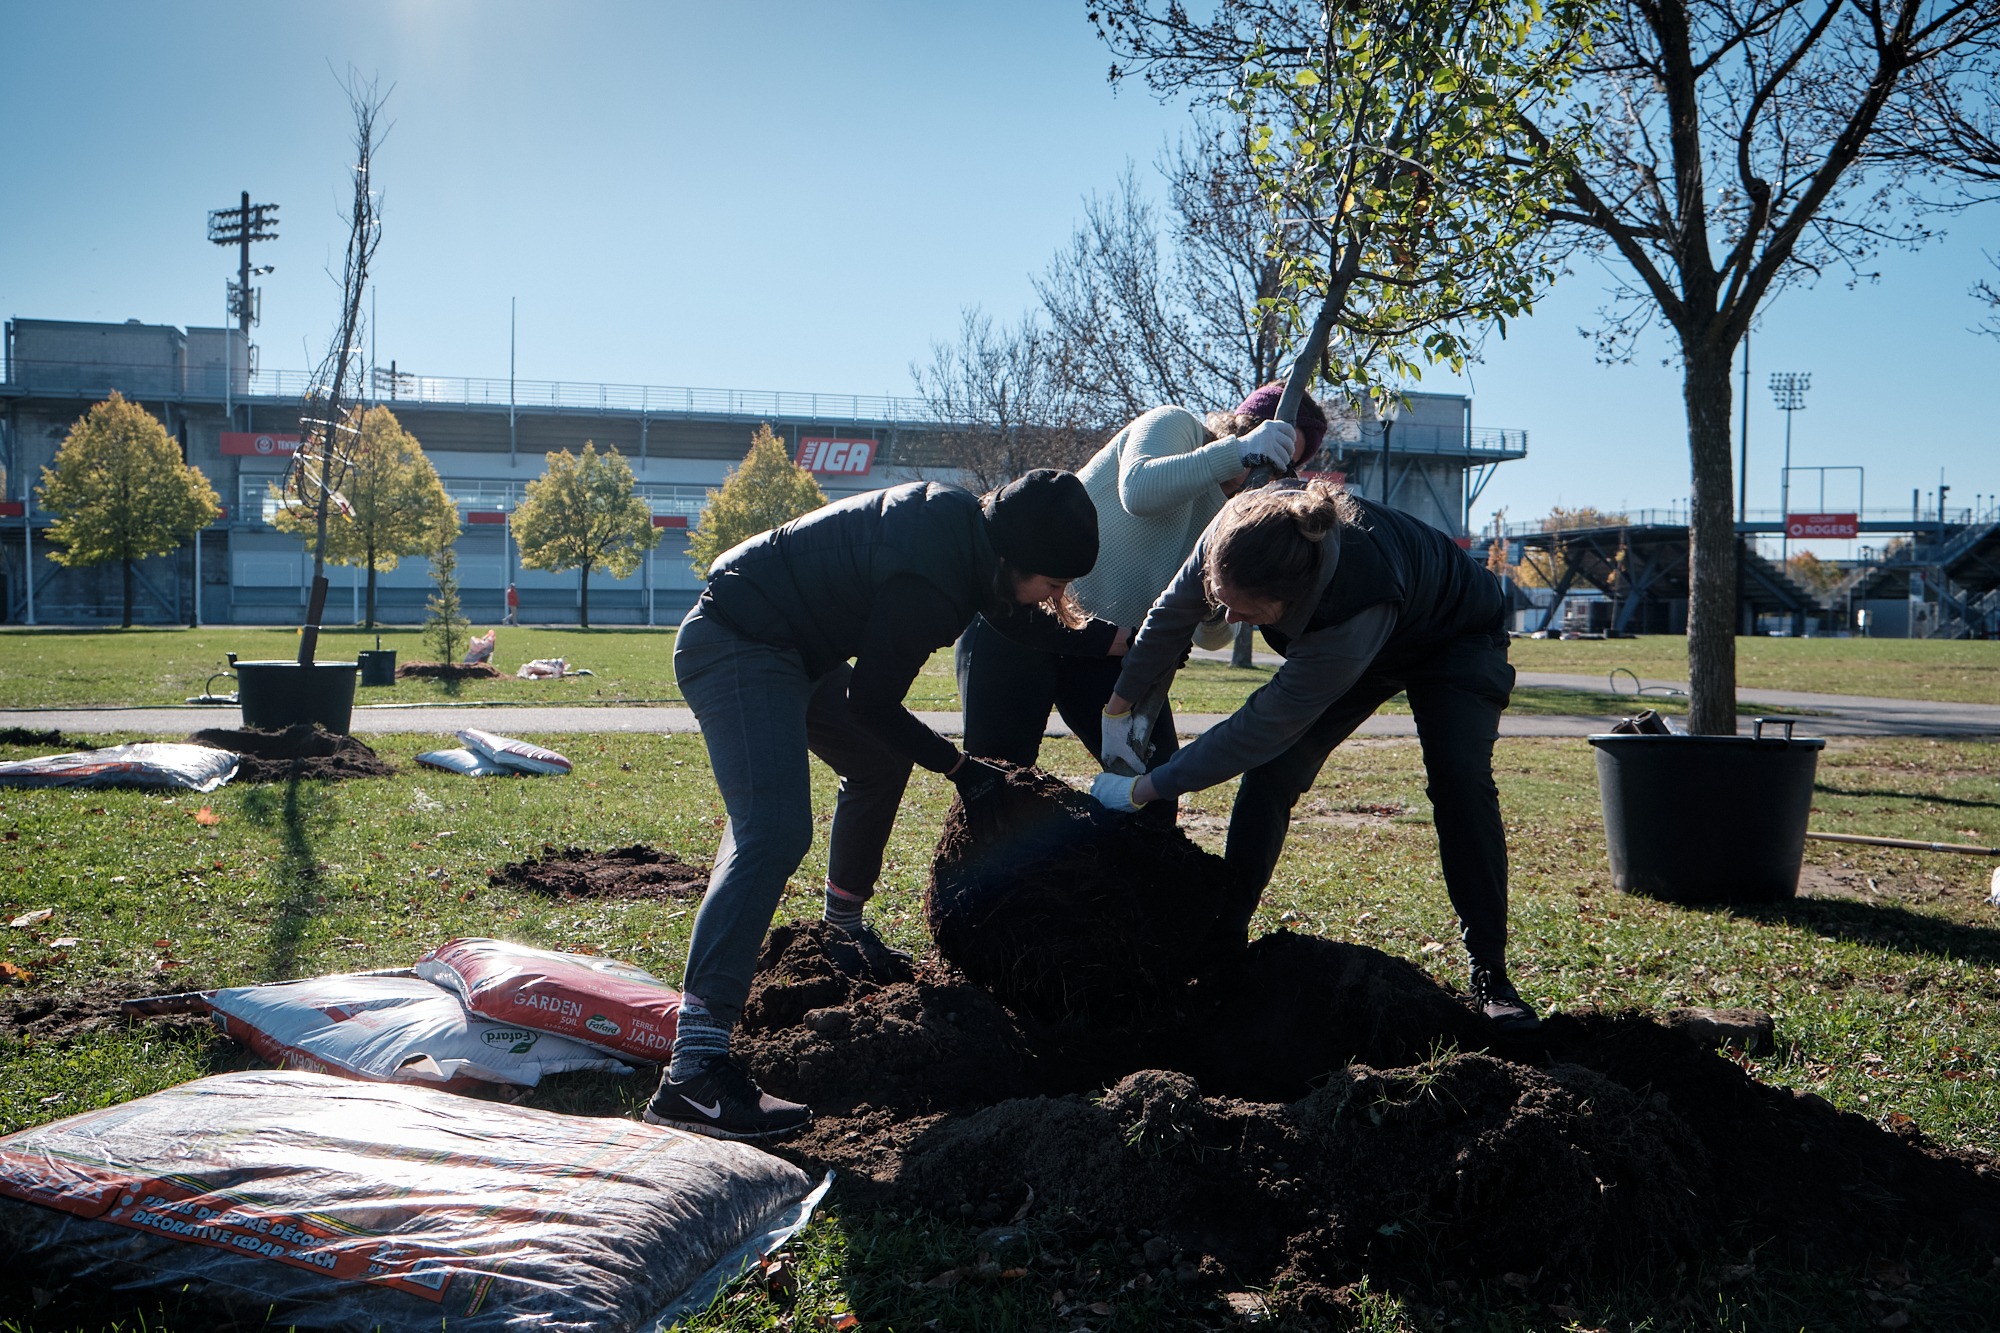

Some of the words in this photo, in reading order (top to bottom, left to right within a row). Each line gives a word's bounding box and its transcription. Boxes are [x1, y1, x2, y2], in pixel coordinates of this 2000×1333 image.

[801, 441, 818, 470] STADE
[811, 442, 870, 472] IGA
[1804, 524, 1854, 535] ROGERS
[514, 992, 583, 1018] GARDEN
[560, 1016, 578, 1027] SOIL
[589, 1019, 619, 1034] Fafard
[631, 1019, 654, 1032] TERRE
[486, 1032, 531, 1043] Fafard
[195, 1206, 220, 1220] DE
[131, 1211, 233, 1244] DECORATIVE
[231, 1234, 285, 1257] CEDAR
[368, 1263, 384, 1274] 85
